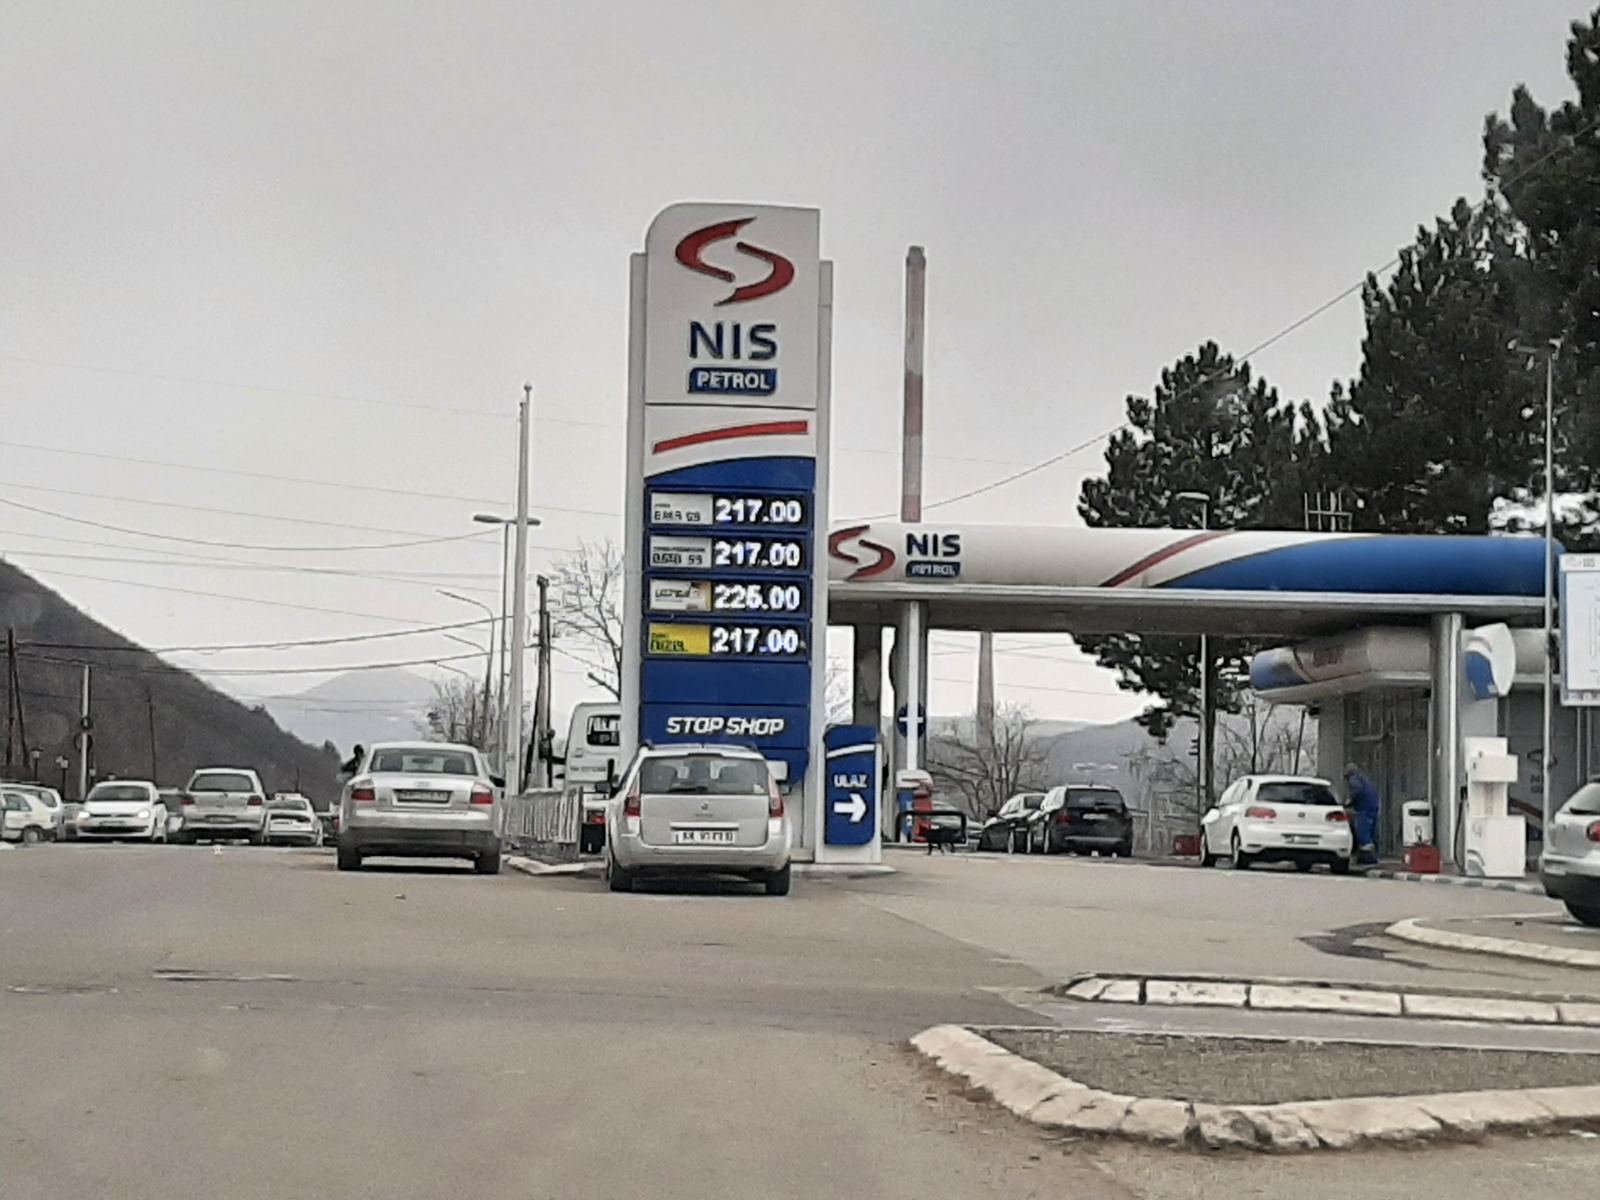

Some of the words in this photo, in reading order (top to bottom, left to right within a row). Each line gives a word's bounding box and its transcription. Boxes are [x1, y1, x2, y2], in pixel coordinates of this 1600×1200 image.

[689, 321, 777, 360] NIS
[697, 370, 770, 389] PETROL
[715, 499, 801, 523] 217.00
[715, 541, 800, 566] 217.00
[906, 532, 961, 557] NIS
[712, 627, 799, 653] 217.00
[666, 716, 724, 734] STOP
[725, 717, 784, 735] SHOP
[833, 774, 868, 788] ULAZ
